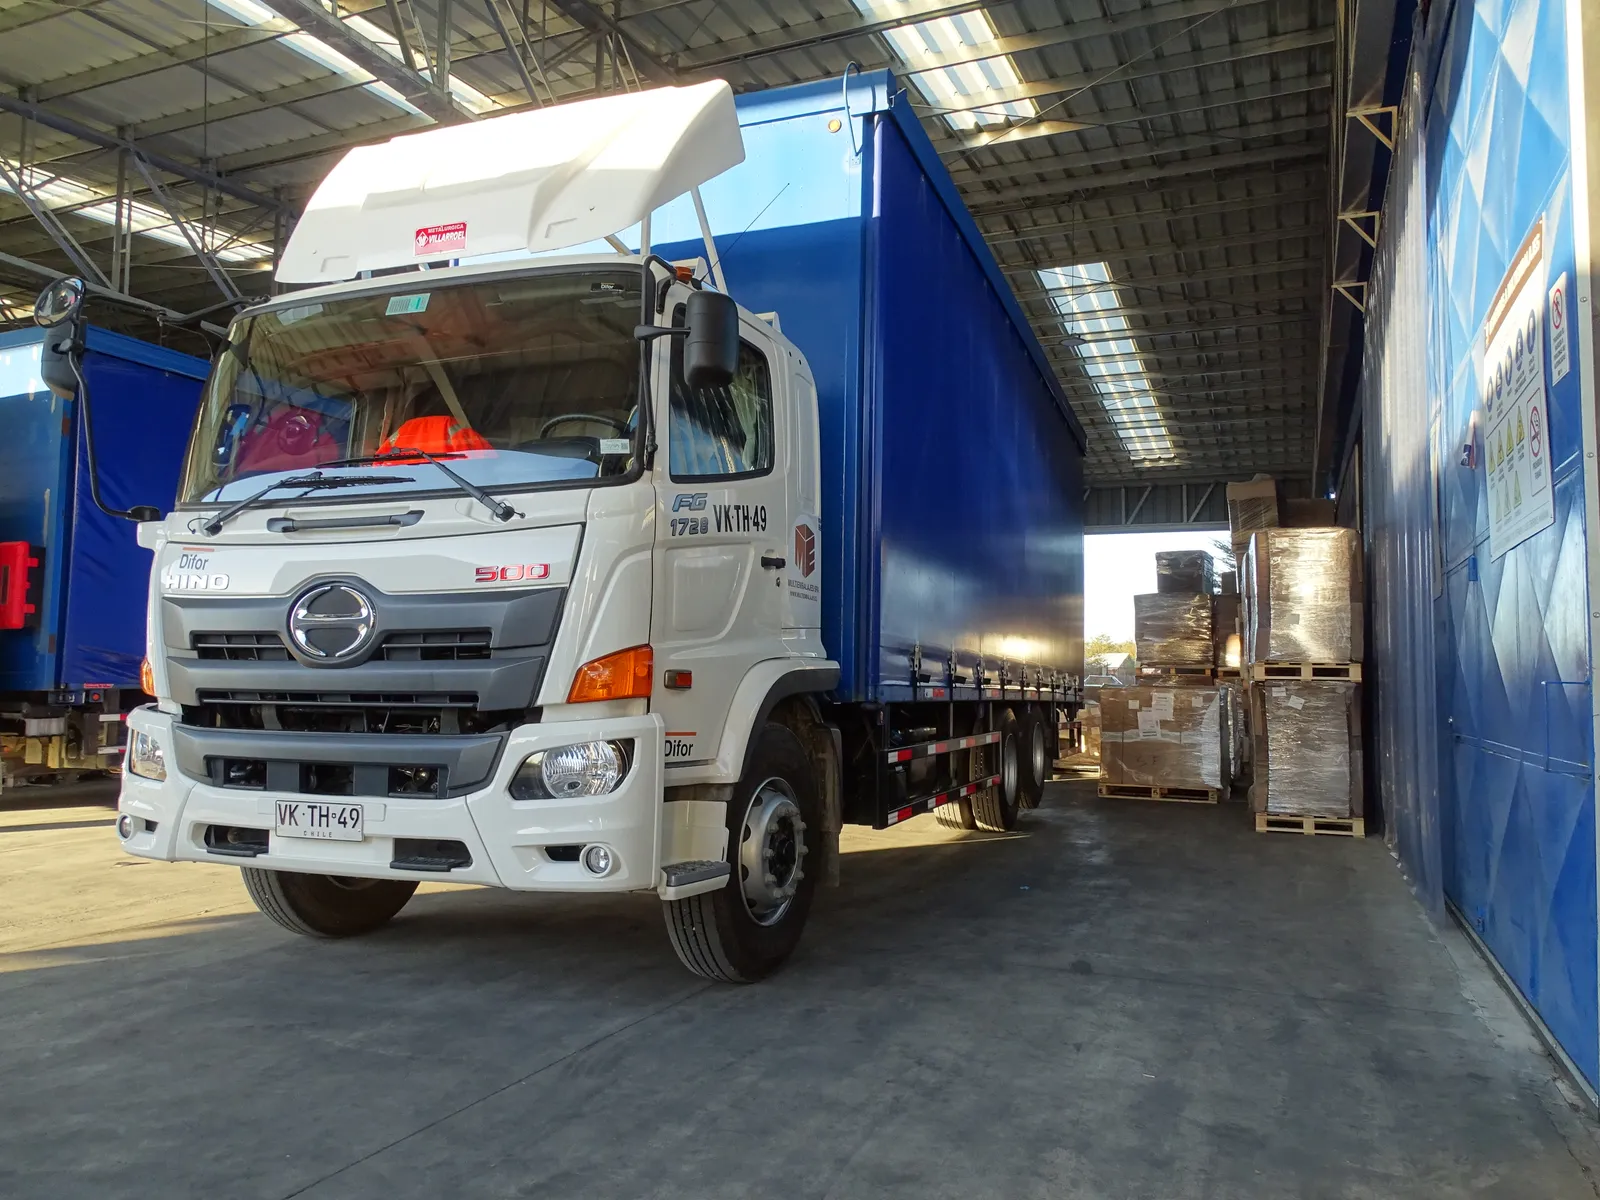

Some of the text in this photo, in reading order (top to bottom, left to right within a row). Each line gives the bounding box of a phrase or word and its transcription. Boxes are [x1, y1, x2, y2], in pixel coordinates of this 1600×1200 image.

[428, 230, 466, 244] VILLARROEL
[671, 492, 709, 513] FG
[670, 516, 710, 537] 1728
[178, 553, 210, 571] Difor
[165, 573, 230, 591] HINO
[474, 563, 551, 583] 500
[664, 739, 694, 757] Difor
[303, 830, 332, 838] CHILE
